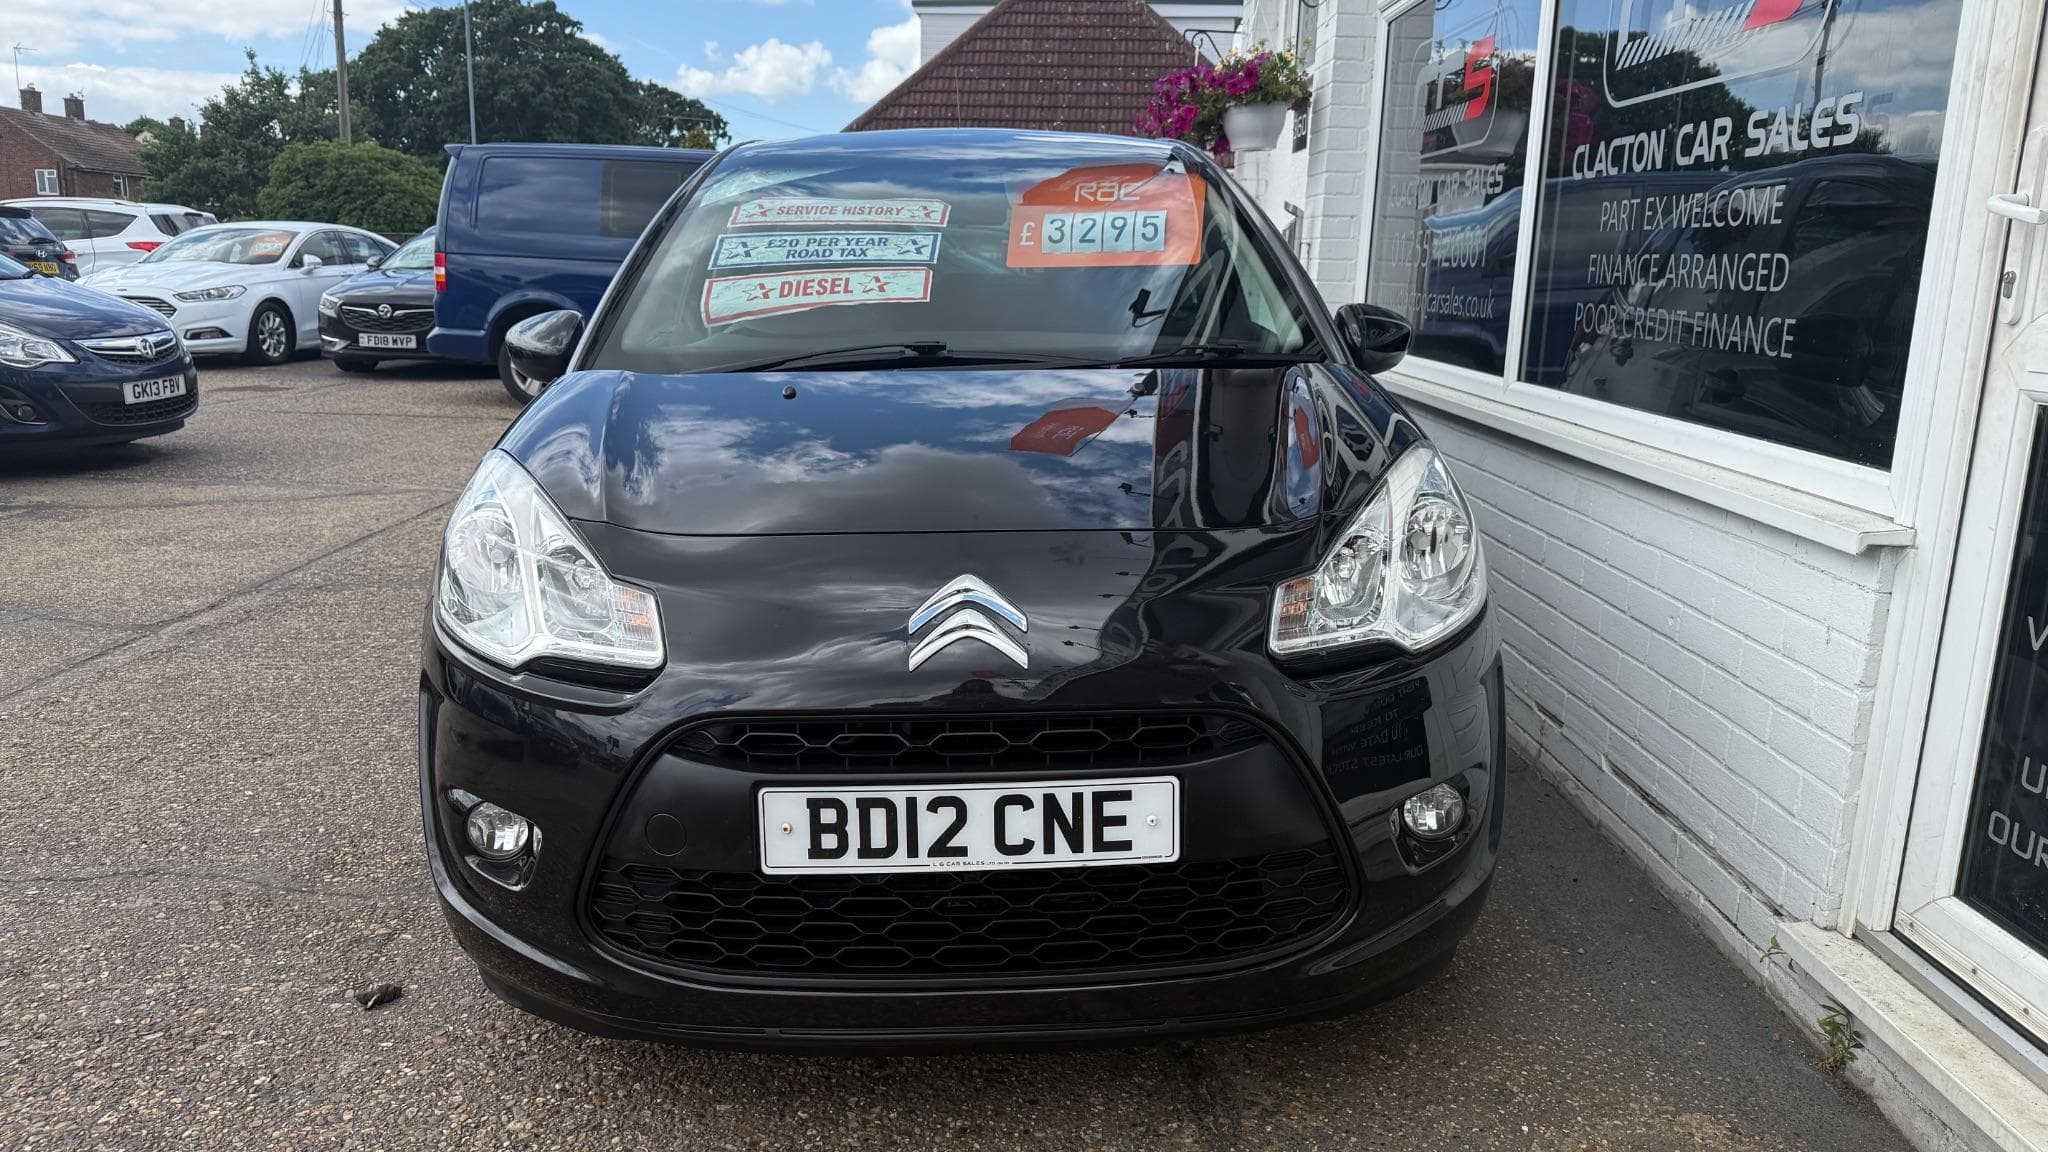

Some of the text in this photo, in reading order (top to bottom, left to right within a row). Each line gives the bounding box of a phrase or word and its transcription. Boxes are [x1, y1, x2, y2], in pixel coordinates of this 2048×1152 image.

[1573, 91, 1863, 180] CLACTON CAR SALES
[1437, 172, 1460, 201] CAR
[1464, 163, 1505, 197] SALES
[777, 205, 904, 217] SERVICE HISTORY
[1600, 184, 1787, 233] PART EX WELCOME
[765, 236, 889, 249] £20 PER YEAR
[785, 248, 869, 260] ROAD TAX
[1587, 252, 1790, 292] FINANCE ARRANGED
[778, 277, 854, 299] DIESEL
[367, 335, 389, 346] FD18
[1573, 302, 1797, 359] POOR CREDIT FINANCE
[132, 376, 181, 399] GK13 FBV
[806, 790, 1133, 860] BD12 CNE
